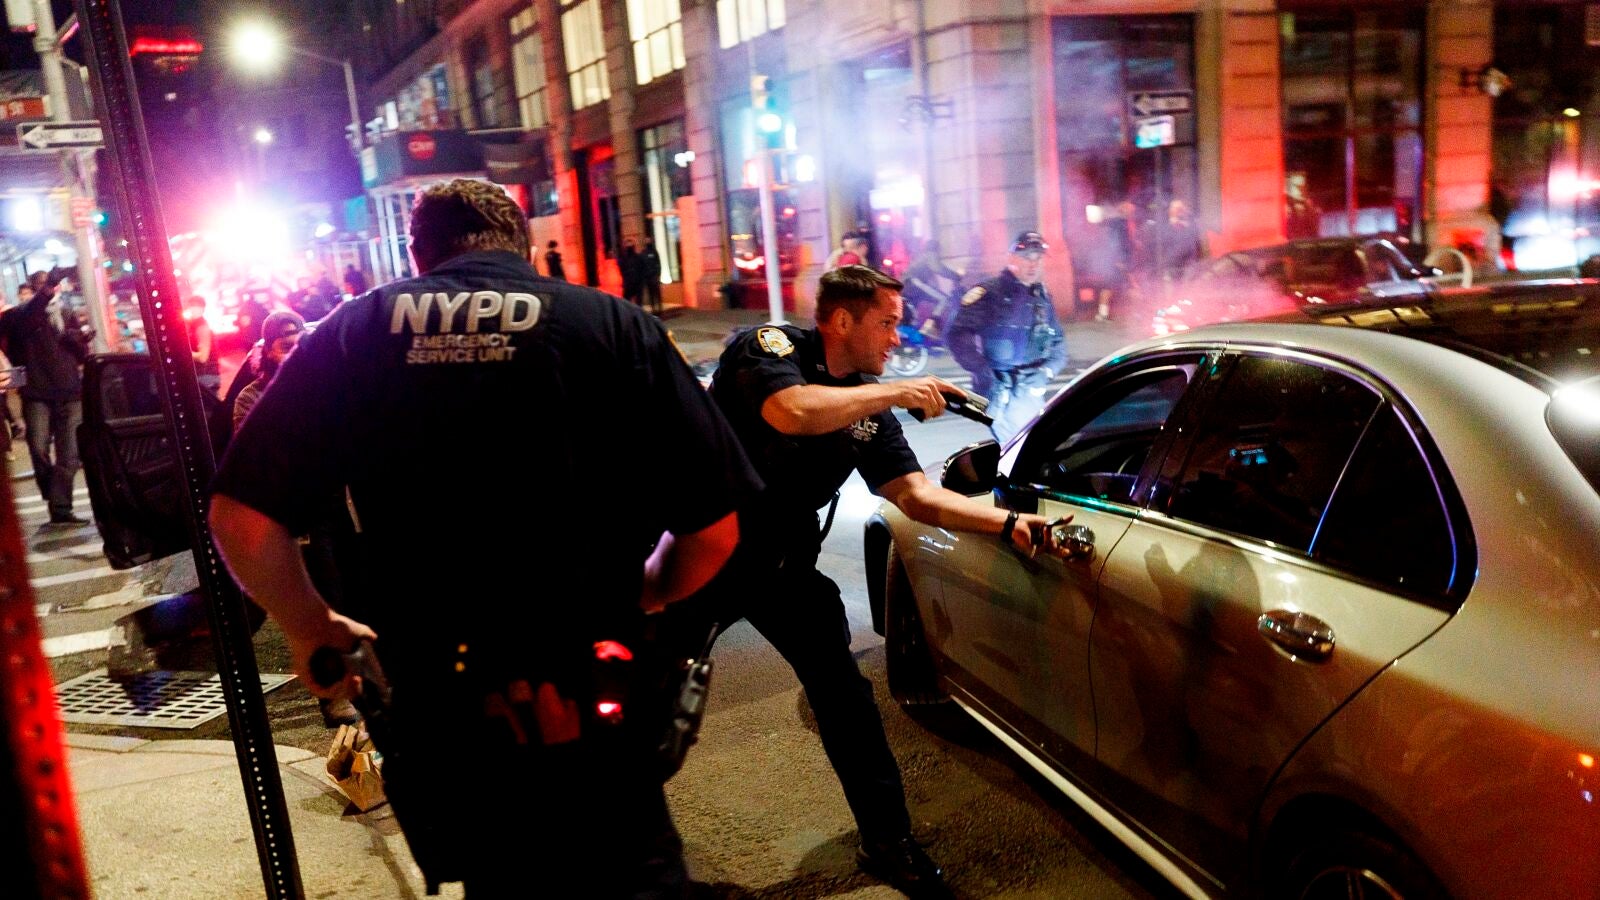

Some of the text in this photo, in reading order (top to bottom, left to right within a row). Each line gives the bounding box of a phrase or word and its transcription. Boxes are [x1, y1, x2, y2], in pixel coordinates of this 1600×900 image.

[390, 290, 542, 334] NYPD
[412, 333, 512, 348] EMERGENCY
[406, 346, 517, 364] SERVICE UNIT
[850, 420, 879, 434] OLICE
